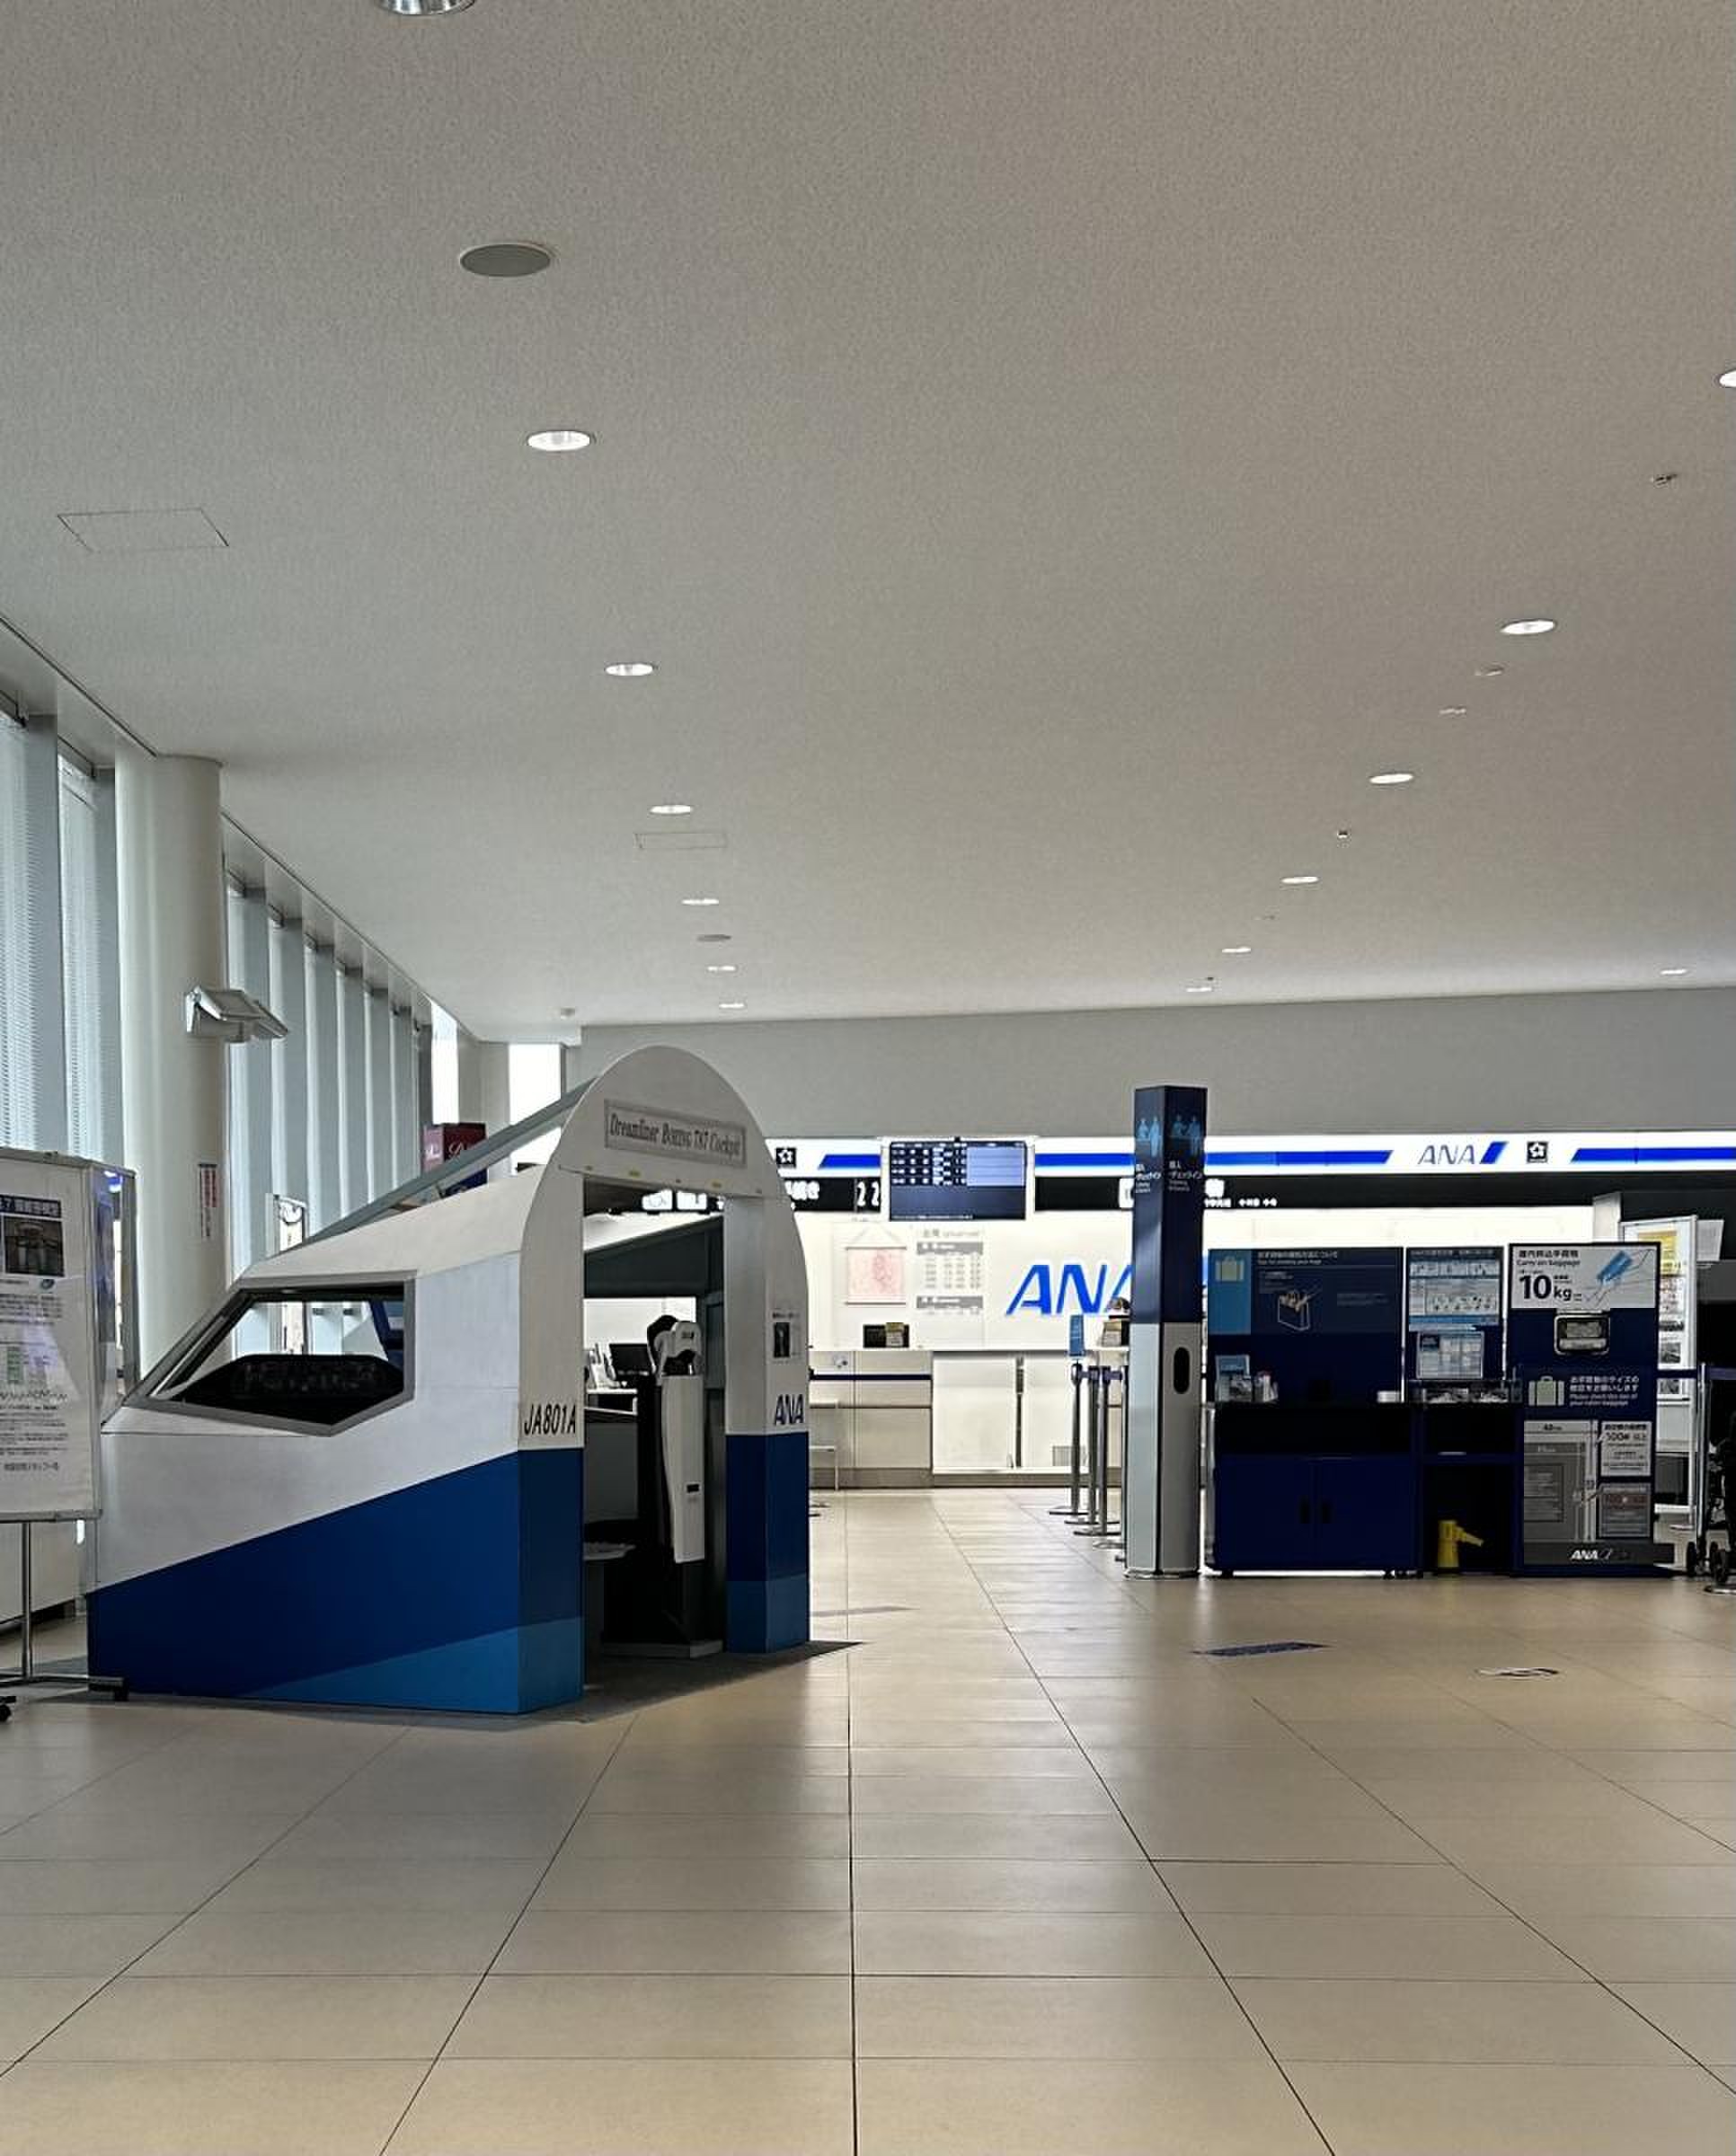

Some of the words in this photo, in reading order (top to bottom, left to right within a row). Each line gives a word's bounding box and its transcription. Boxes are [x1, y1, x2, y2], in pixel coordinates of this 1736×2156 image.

[1418, 1144, 1475, 1165] ANA
[1005, 1264, 1133, 1315] AN
[1519, 1275, 1552, 1300] 10
[1554, 1286, 1572, 1302] kg
[524, 1404, 576, 1435] JA801A
[775, 1394, 804, 1426] ANA
[1571, 1550, 1599, 1560] ANA
